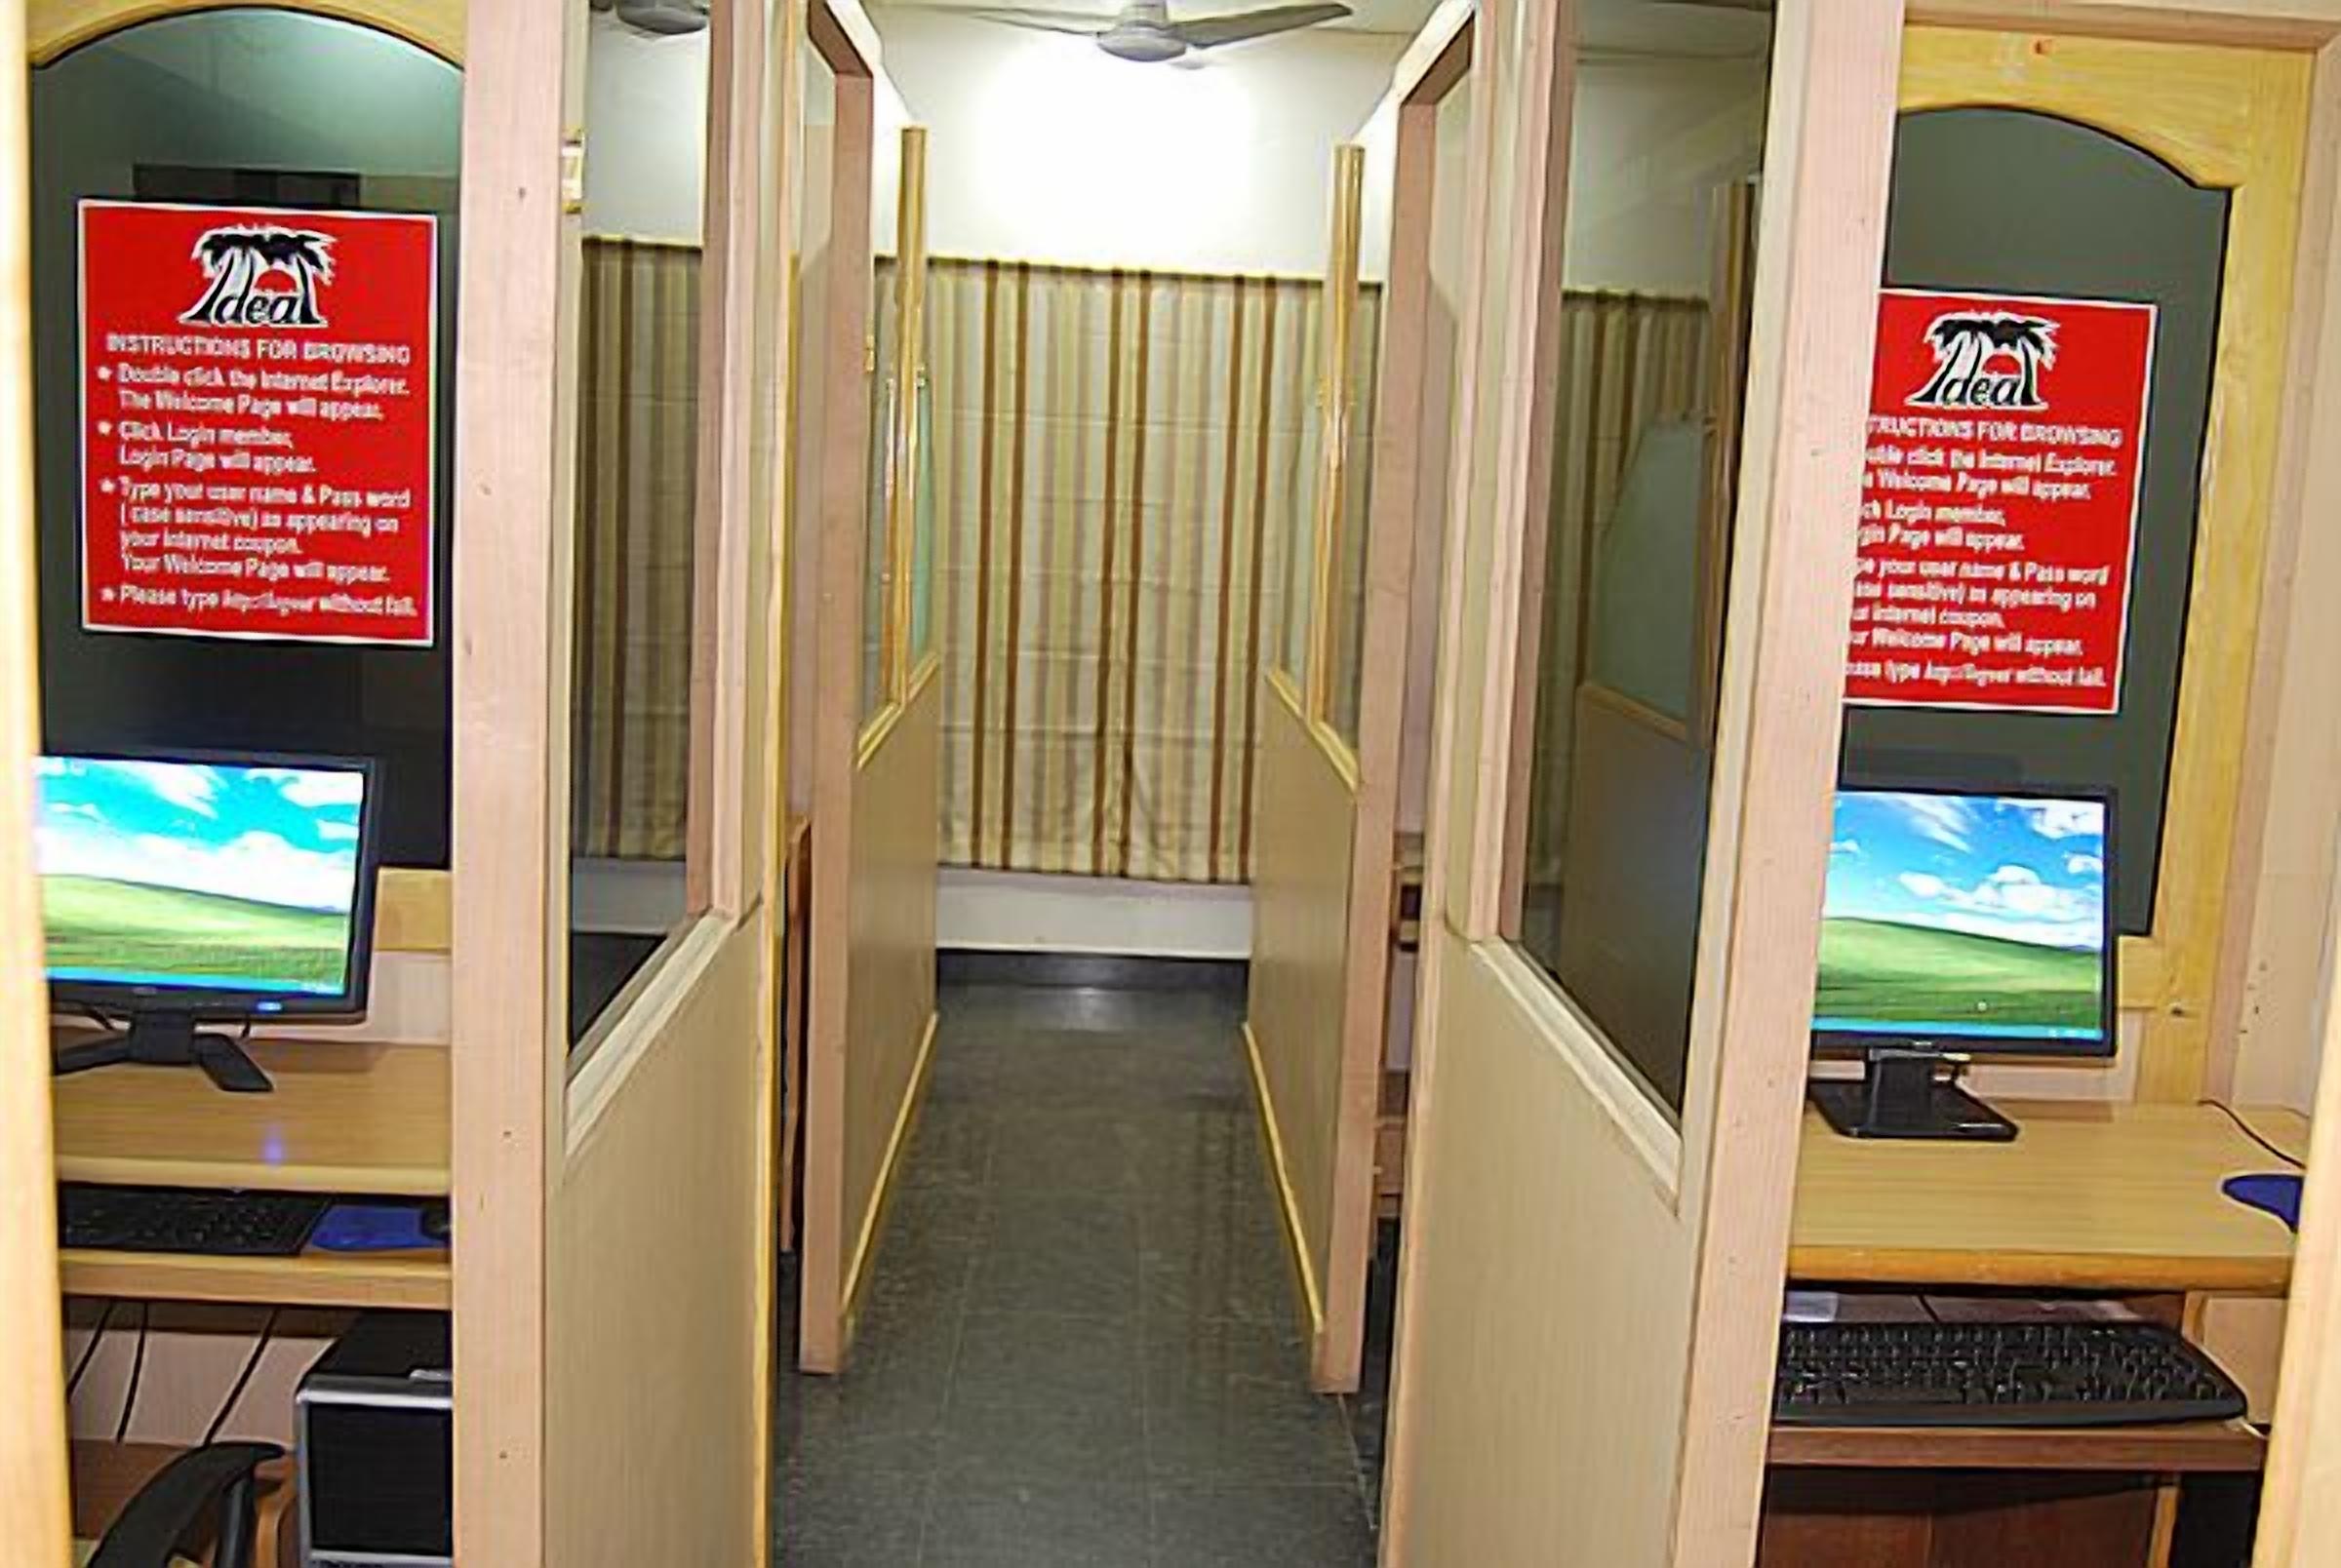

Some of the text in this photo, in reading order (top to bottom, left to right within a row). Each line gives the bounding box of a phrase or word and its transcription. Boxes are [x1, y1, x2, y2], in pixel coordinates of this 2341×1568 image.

[106, 333, 411, 367] INSTRUCTIONS FOR BROWSING
[118, 362, 180, 386] Double
[183, 367, 226, 388] click
[230, 370, 258, 389] the
[118, 389, 150, 411] The
[154, 389, 235, 414] Welcome
[237, 393, 282, 419] Page
[286, 398, 318, 417] will
[118, 421, 164, 441] Click
[167, 422, 216, 449] Login
[1977, 420, 2017, 443] FOR
[2020, 423, 2123, 449] BROWSING
[119, 444, 169, 472] Login
[170, 449, 216, 472] Page
[218, 451, 252, 469] will
[1906, 447, 1944, 467] click
[1951, 449, 1975, 469] the
[117, 476, 161, 503] Type
[164, 484, 203, 504] your
[206, 487, 246, 502] user
[249, 488, 298, 504] name
[301, 485, 316, 504] &
[366, 489, 411, 508] word
[1877, 468, 1952, 492] Welcome
[1956, 472, 1998, 499] Page
[2001, 476, 2030, 495] will
[286, 512, 372, 538] appearing
[374, 518, 399, 532] on
[1885, 499, 1932, 527] Login
[120, 531, 160, 557] your
[1887, 523, 1930, 550] Page
[1933, 528, 1964, 547] will
[121, 554, 161, 573] Your
[163, 554, 243, 576] Welcome
[244, 557, 290, 582] Page
[293, 562, 325, 578] will
[1879, 560, 1916, 578] your
[1919, 561, 1958, 577] user
[1959, 563, 2004, 580] name
[2007, 562, 2021, 581] &
[2024, 562, 2065, 583] Pass
[2067, 565, 2111, 586] word
[119, 584, 177, 606] Please
[179, 588, 219, 612] type
[319, 593, 383, 614] without
[1991, 586, 2073, 612] appearing
[2075, 592, 2096, 609] on
[1872, 627, 1947, 648] Welcome
[1949, 631, 1990, 655] Page
[1993, 633, 2023, 652] will
[1884, 659, 1921, 684] type
[2016, 665, 2073, 686] without
